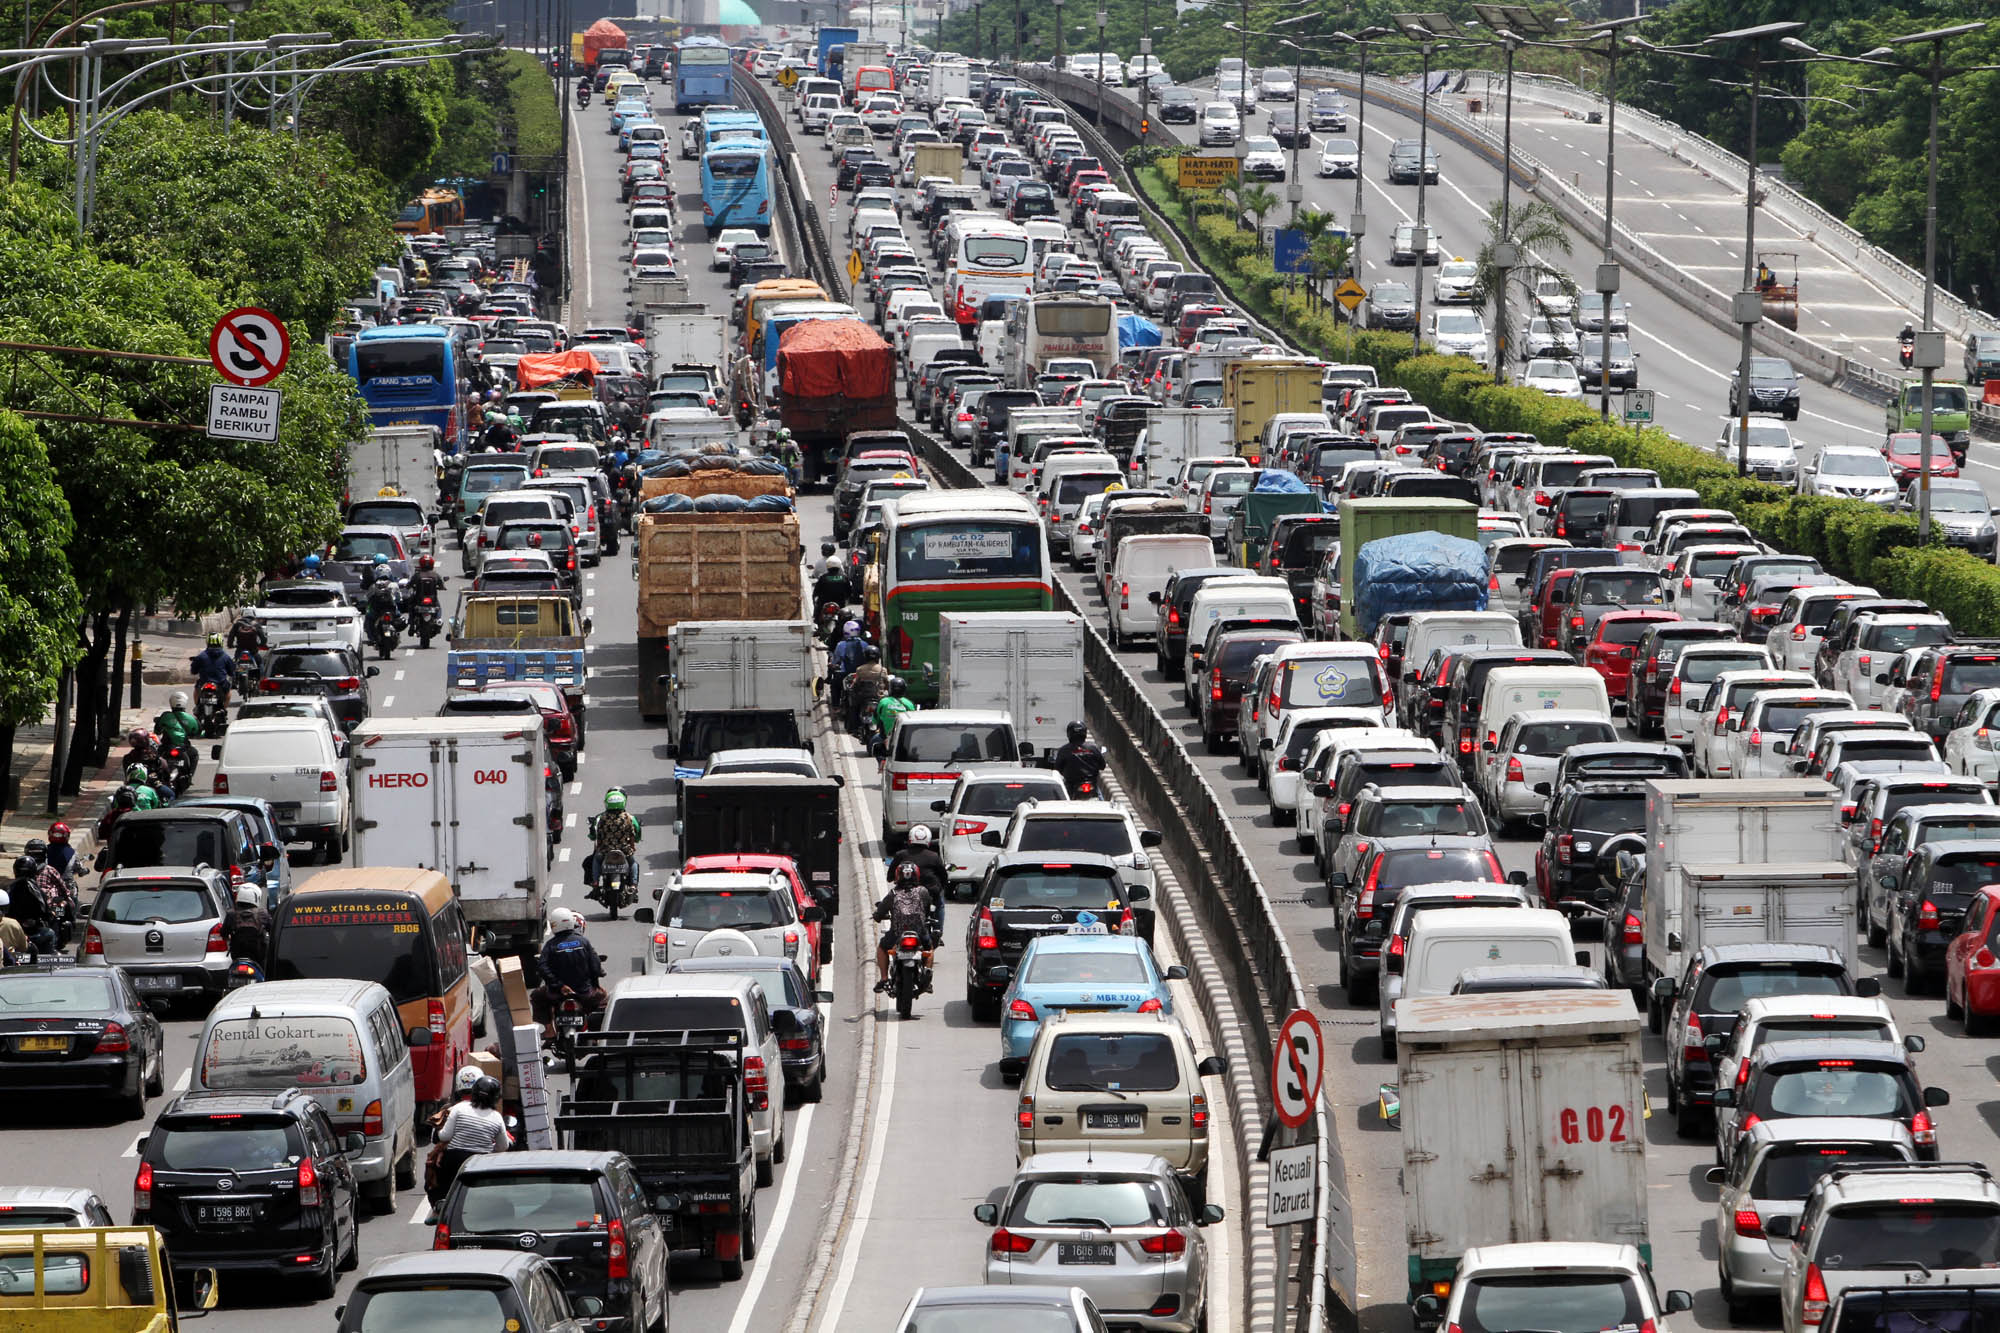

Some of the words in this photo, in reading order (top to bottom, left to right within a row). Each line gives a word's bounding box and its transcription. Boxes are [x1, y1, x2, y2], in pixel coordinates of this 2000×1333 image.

[1185, 160, 1234, 168] HATI-HATI
[220, 392, 269, 406] SAMPAI
[1635, 401, 1643, 410] 6
[220, 406, 268, 419] RAMBU
[214, 420, 271, 433] BERIKUT
[368, 773, 429, 788] HERO
[473, 769, 508, 785] 040
[291, 914, 348, 925] AIRPORT
[351, 912, 412, 923] EXPRESS
[1096, 994, 1117, 1002] MBR
[214, 1026, 260, 1041] Rental
[264, 1025, 316, 1039] Gokart
[1087, 1114, 1094, 1124] B
[1274, 1155, 1312, 1183] Kecuali
[1273, 1188, 1311, 1215] Darurat
[200, 1207, 206, 1217] B
[213, 1207, 232, 1217] 1596
[235, 1206, 251, 1217] BRX
[1059, 1245, 1065, 1256] B
[1098, 1245, 1115, 1257] URK
